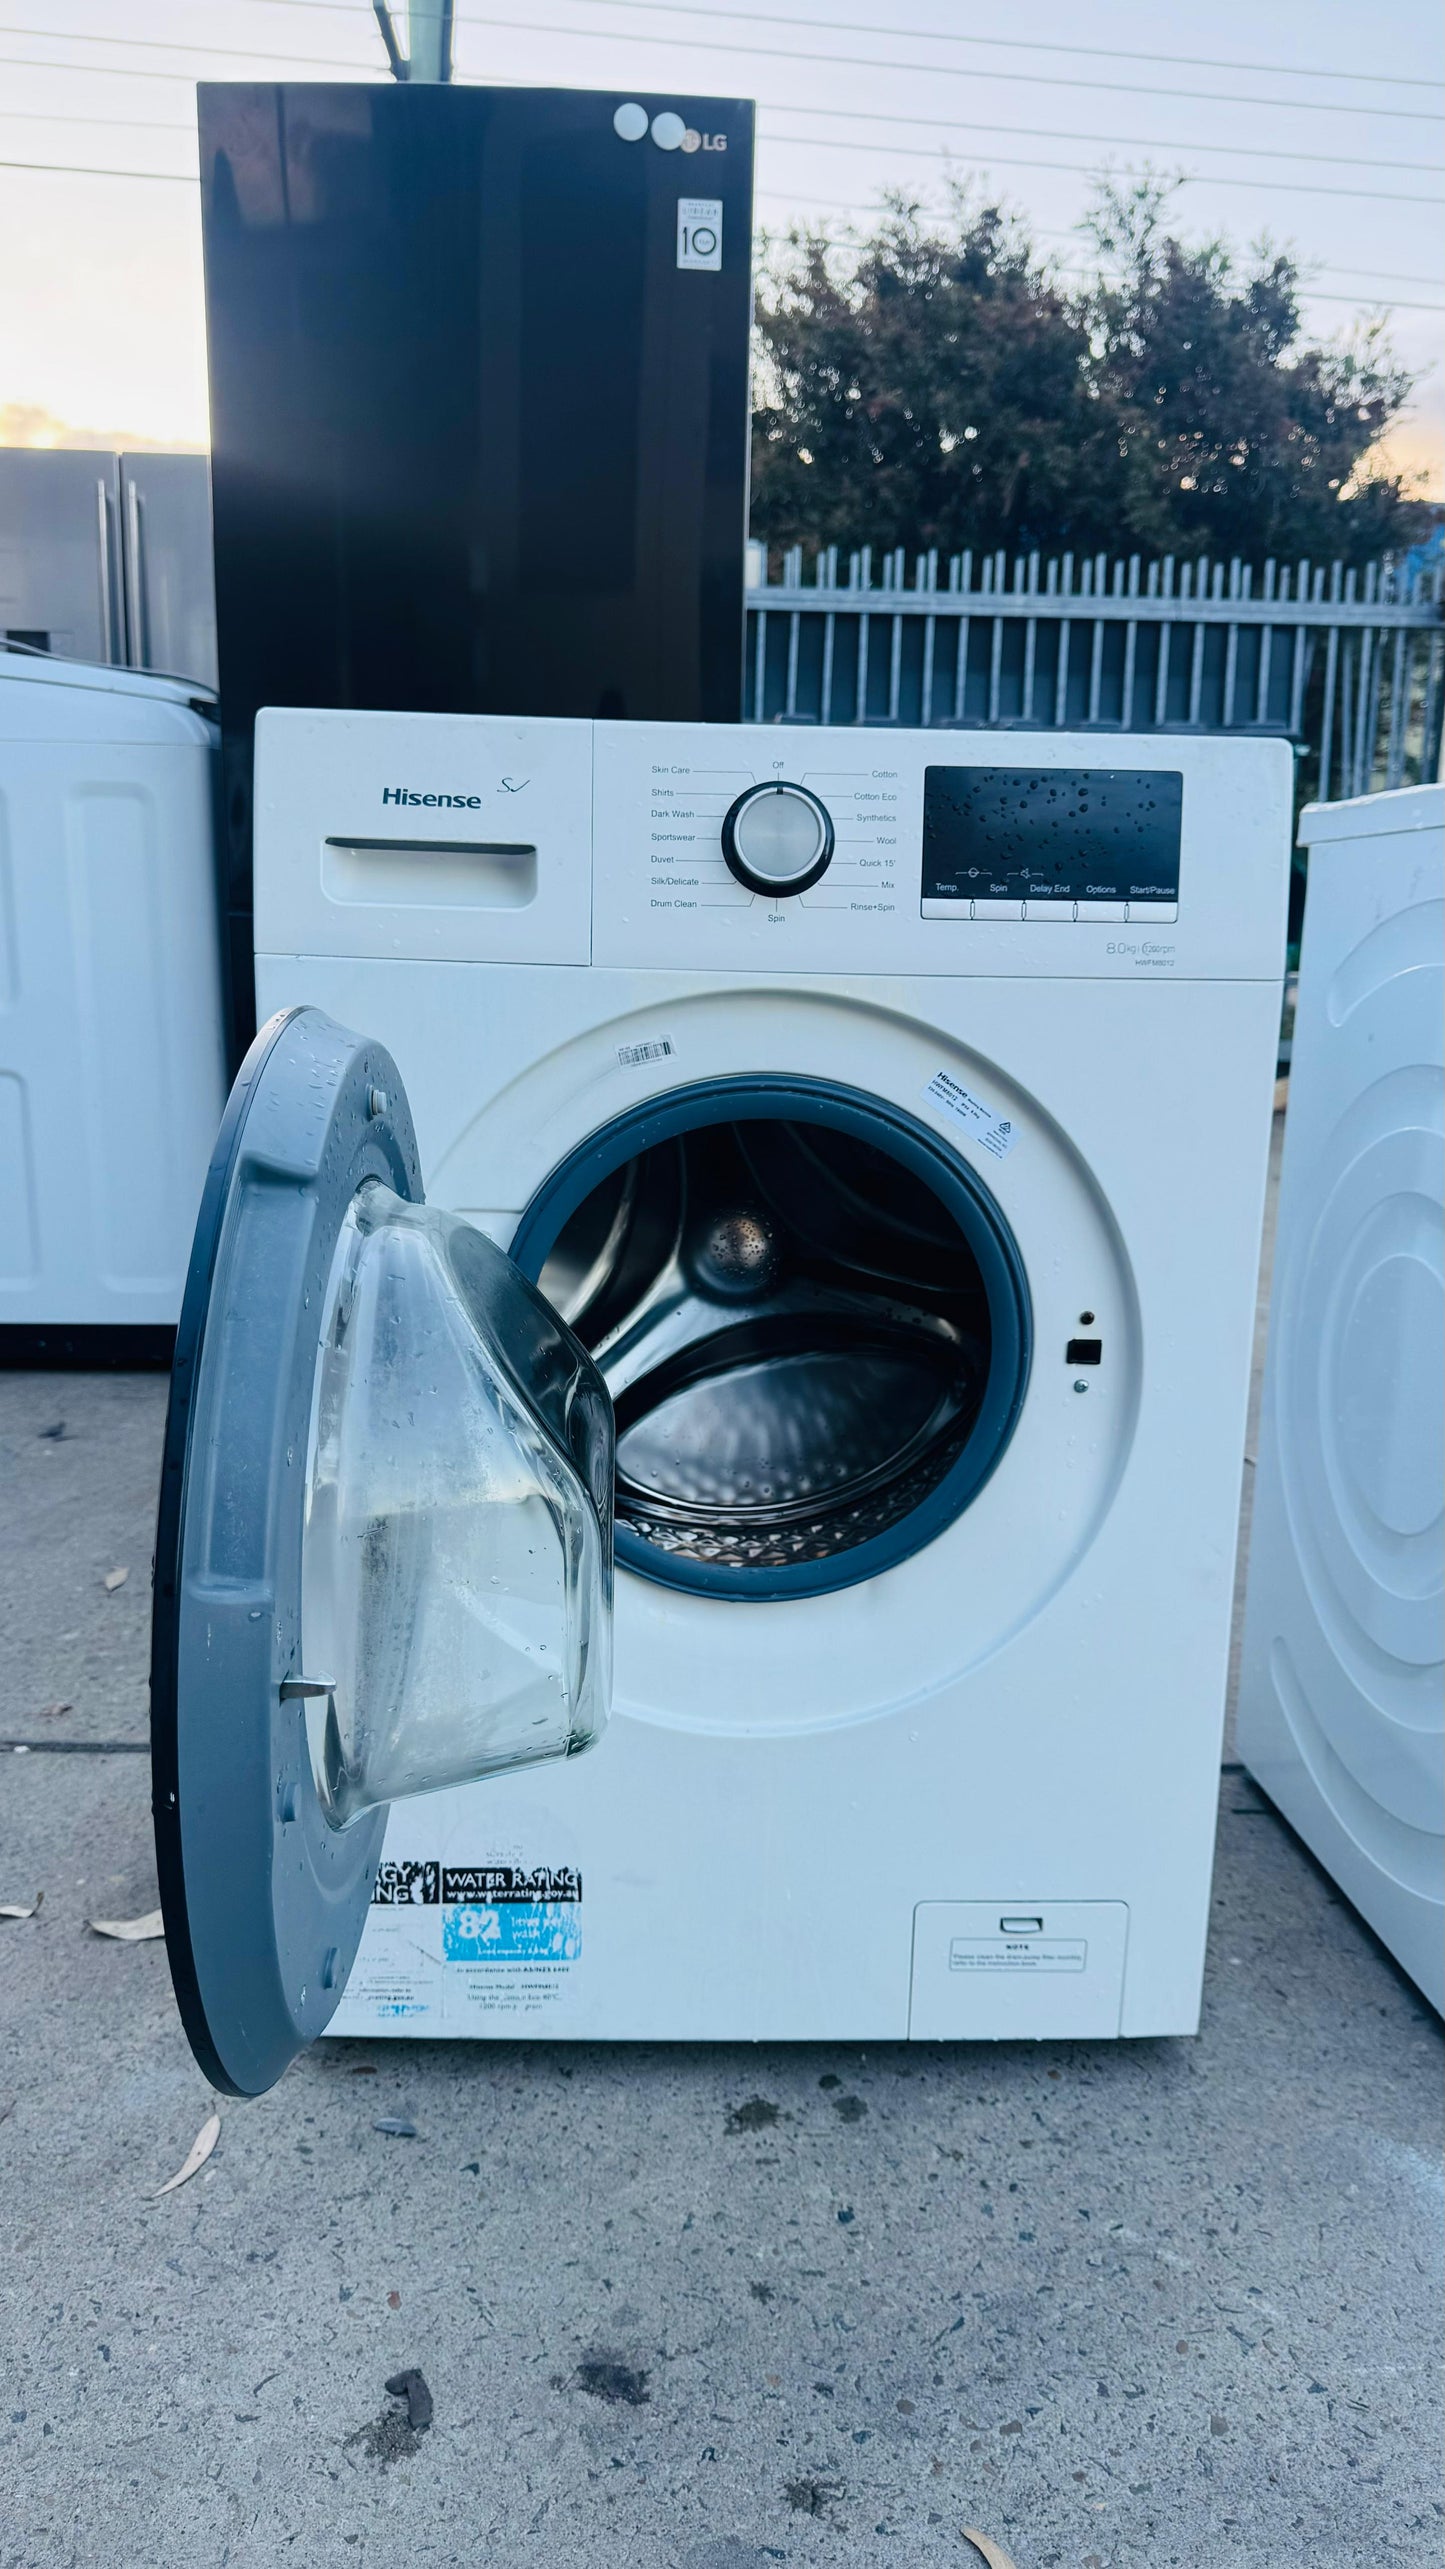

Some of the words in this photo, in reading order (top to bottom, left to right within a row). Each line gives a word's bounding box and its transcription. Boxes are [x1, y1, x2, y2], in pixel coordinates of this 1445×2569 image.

[702, 134, 727, 151] LG
[682, 227, 716, 255] 10
[651, 766, 669, 774] Skin
[671, 766, 690, 774] Care
[772, 761, 784, 770] Off
[872, 770, 898, 778] Cotton
[651, 789, 674, 797] Shirts
[854, 792, 879, 801] Cotton
[881, 793, 897, 801] Eco
[382, 787, 482, 809] Hisense
[651, 810, 670, 818] Dark
[671, 810, 695, 819] Wash
[856, 814, 897, 823] Synthetics
[651, 833, 696, 843] Sportswear
[876, 837, 897, 845] Wool
[651, 856, 675, 864] Duvet
[859, 859, 882, 868] Quick
[885, 859, 896, 867] 15'
[651, 877, 699, 886] Silk/Delicate
[881, 881, 895, 889] Mix
[935, 882, 959, 892] Temp.
[989, 883, 1008, 893] Spin
[1029, 884, 1051, 895] Delay
[1053, 884, 1071, 893] End
[1086, 885, 1117, 895] Options
[1129, 885, 1175, 895] Start/Pause
[651, 899, 672, 908] Drum
[674, 900, 697, 908] Clean
[851, 903, 895, 912] Rinse+Spin
[767, 914, 786, 923] Spin
[937, 1072, 968, 1098] Hisense
[446, 1872, 506, 1887] WATER
[512, 1871, 578, 1889] RATING
[458, 1910, 501, 1940] 82
